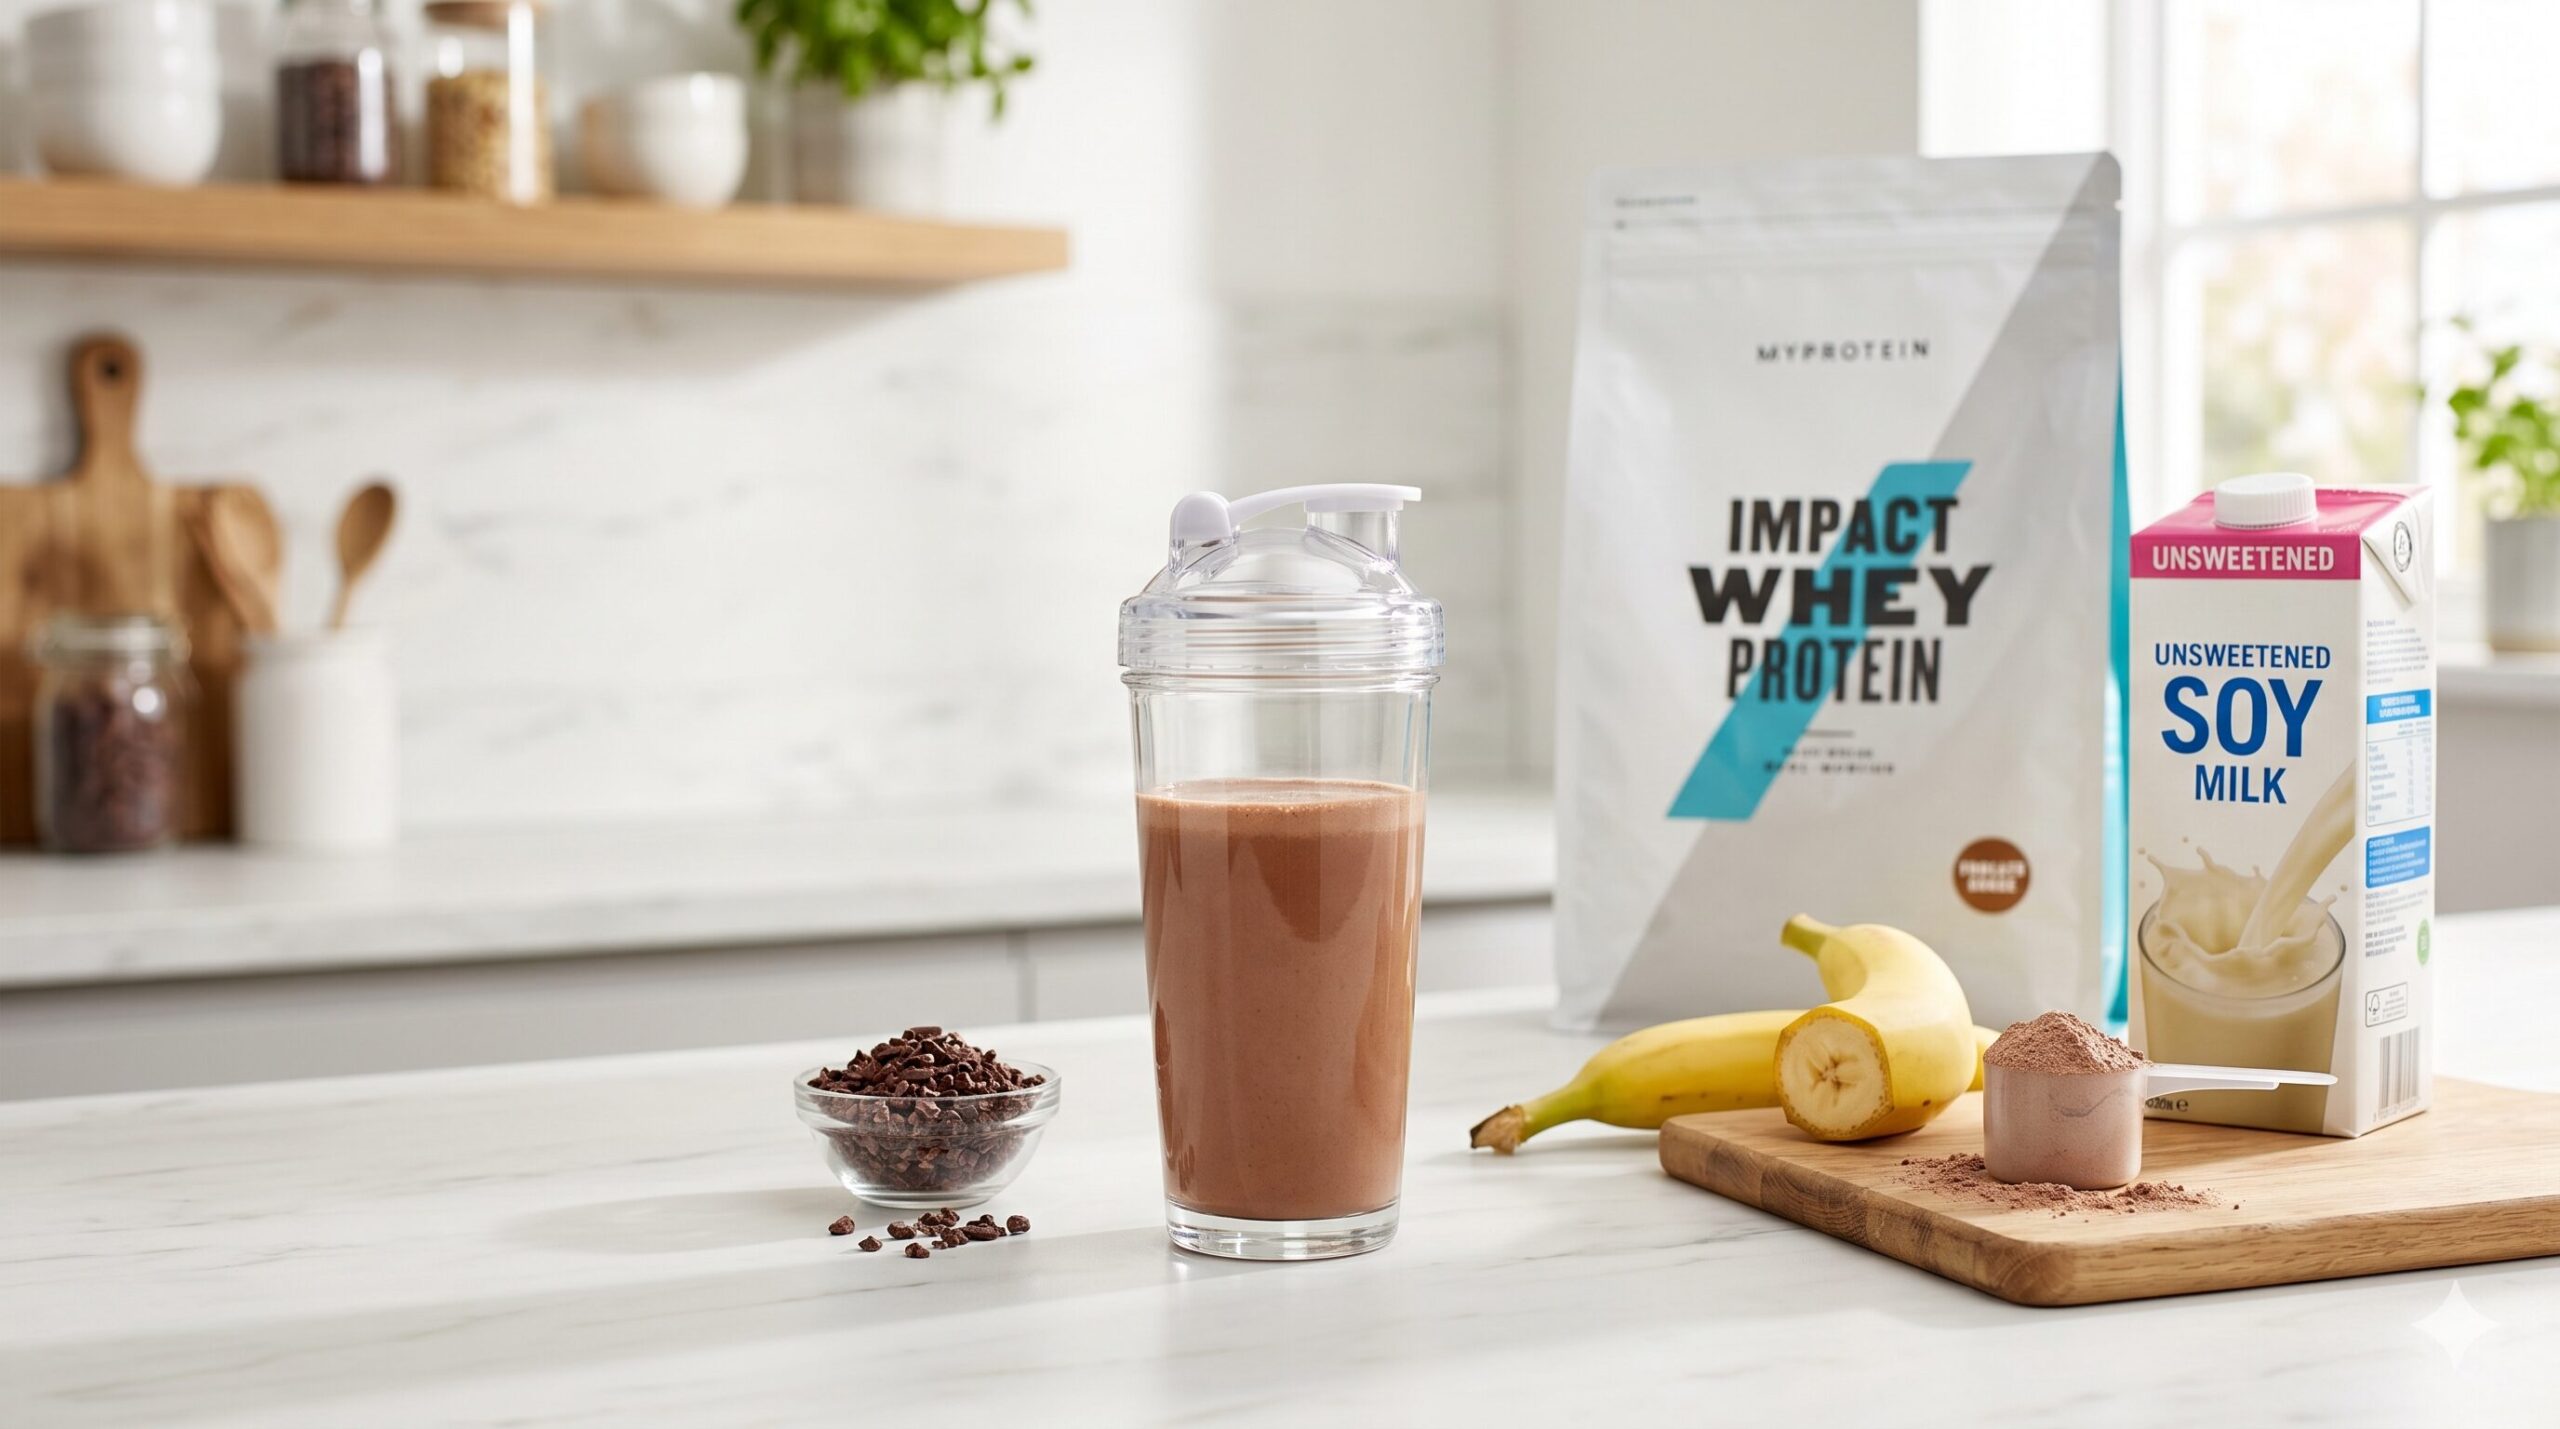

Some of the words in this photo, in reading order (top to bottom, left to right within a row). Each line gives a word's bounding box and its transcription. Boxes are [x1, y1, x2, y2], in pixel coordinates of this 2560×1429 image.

[1757, 341, 1930, 362] MYPROTEIN
[1729, 497, 1958, 555] IMPACT
[2153, 546, 2334, 571] UNSWEETENED
[1688, 564, 1992, 626] WHEY
[1728, 637, 1942, 702] PROTEIN
[2155, 643, 2330, 669] UNSWEETENED
[2161, 676, 2323, 757] SOY
[2195, 765, 2287, 804] MILK
